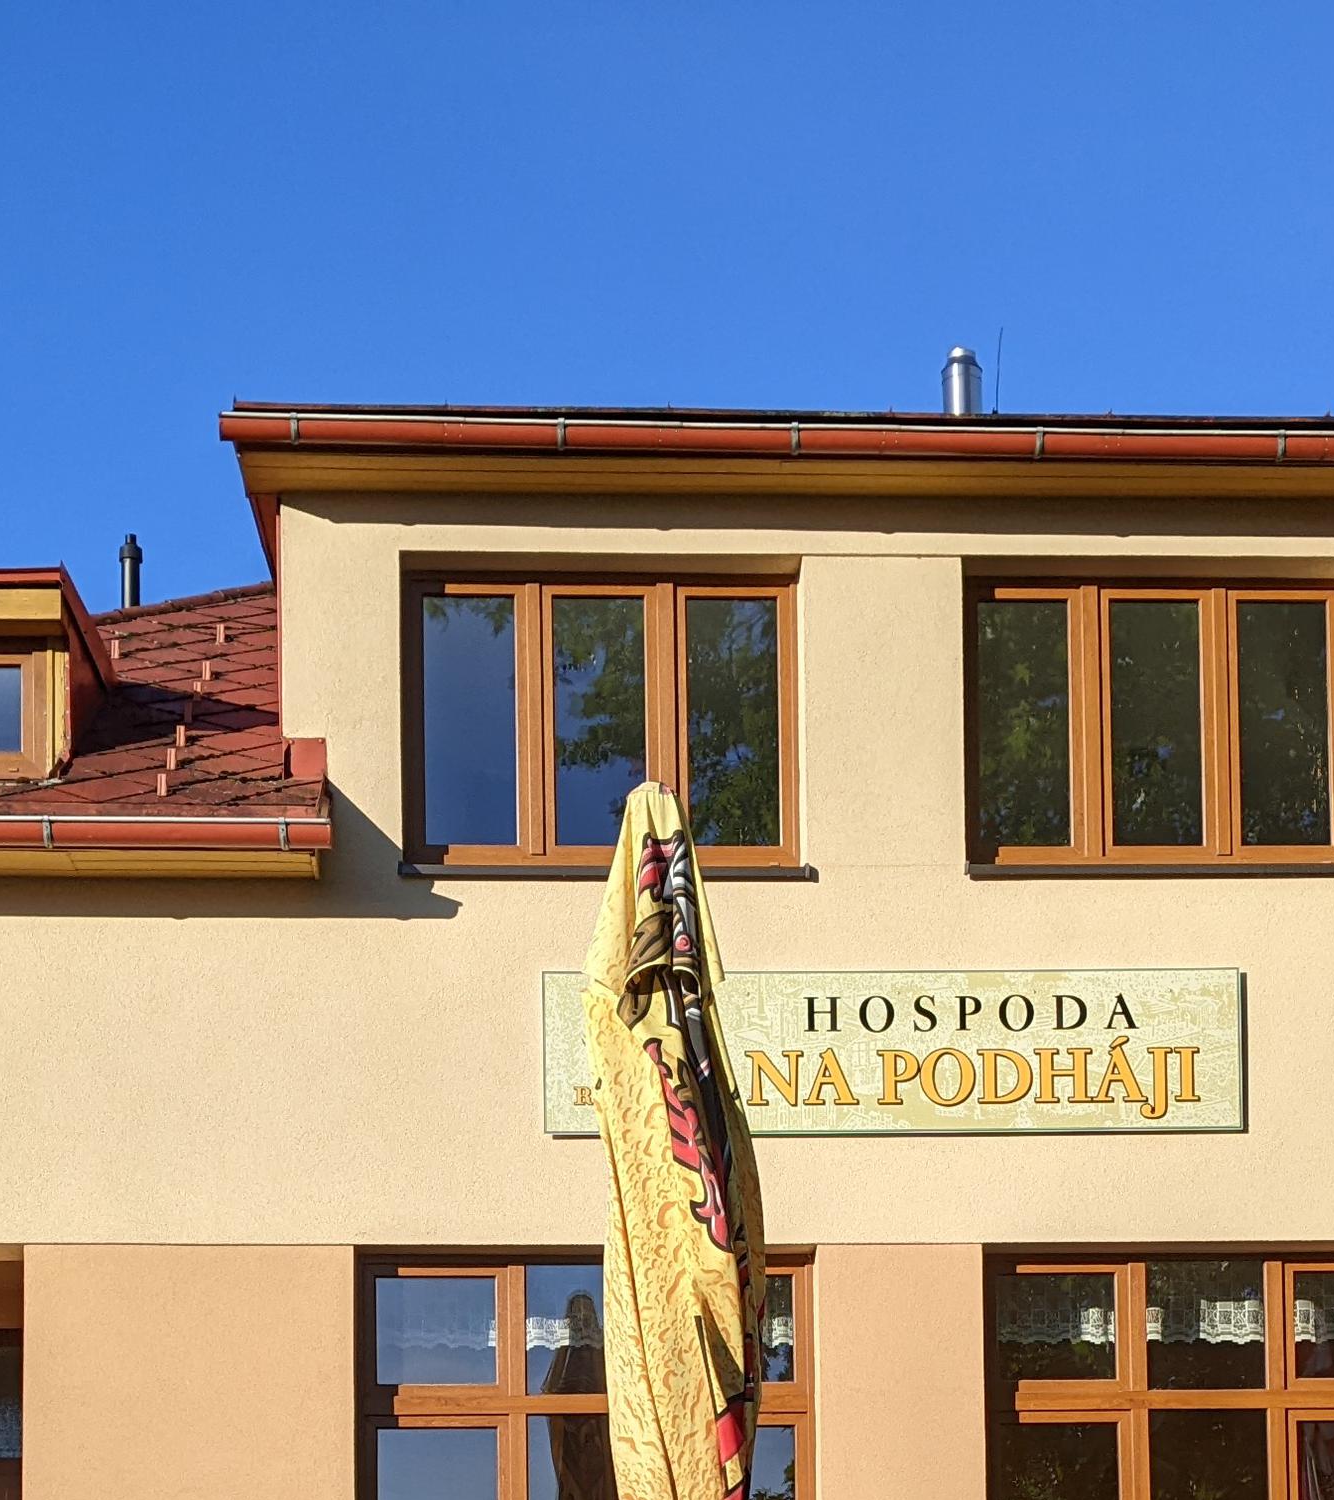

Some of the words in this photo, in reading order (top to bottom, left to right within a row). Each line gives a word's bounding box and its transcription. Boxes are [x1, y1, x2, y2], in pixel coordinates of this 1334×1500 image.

[802, 992, 1139, 1034] HOSPODA
[745, 1047, 860, 1107] NA
[876, 1035, 1202, 1120] PODHÁJI
